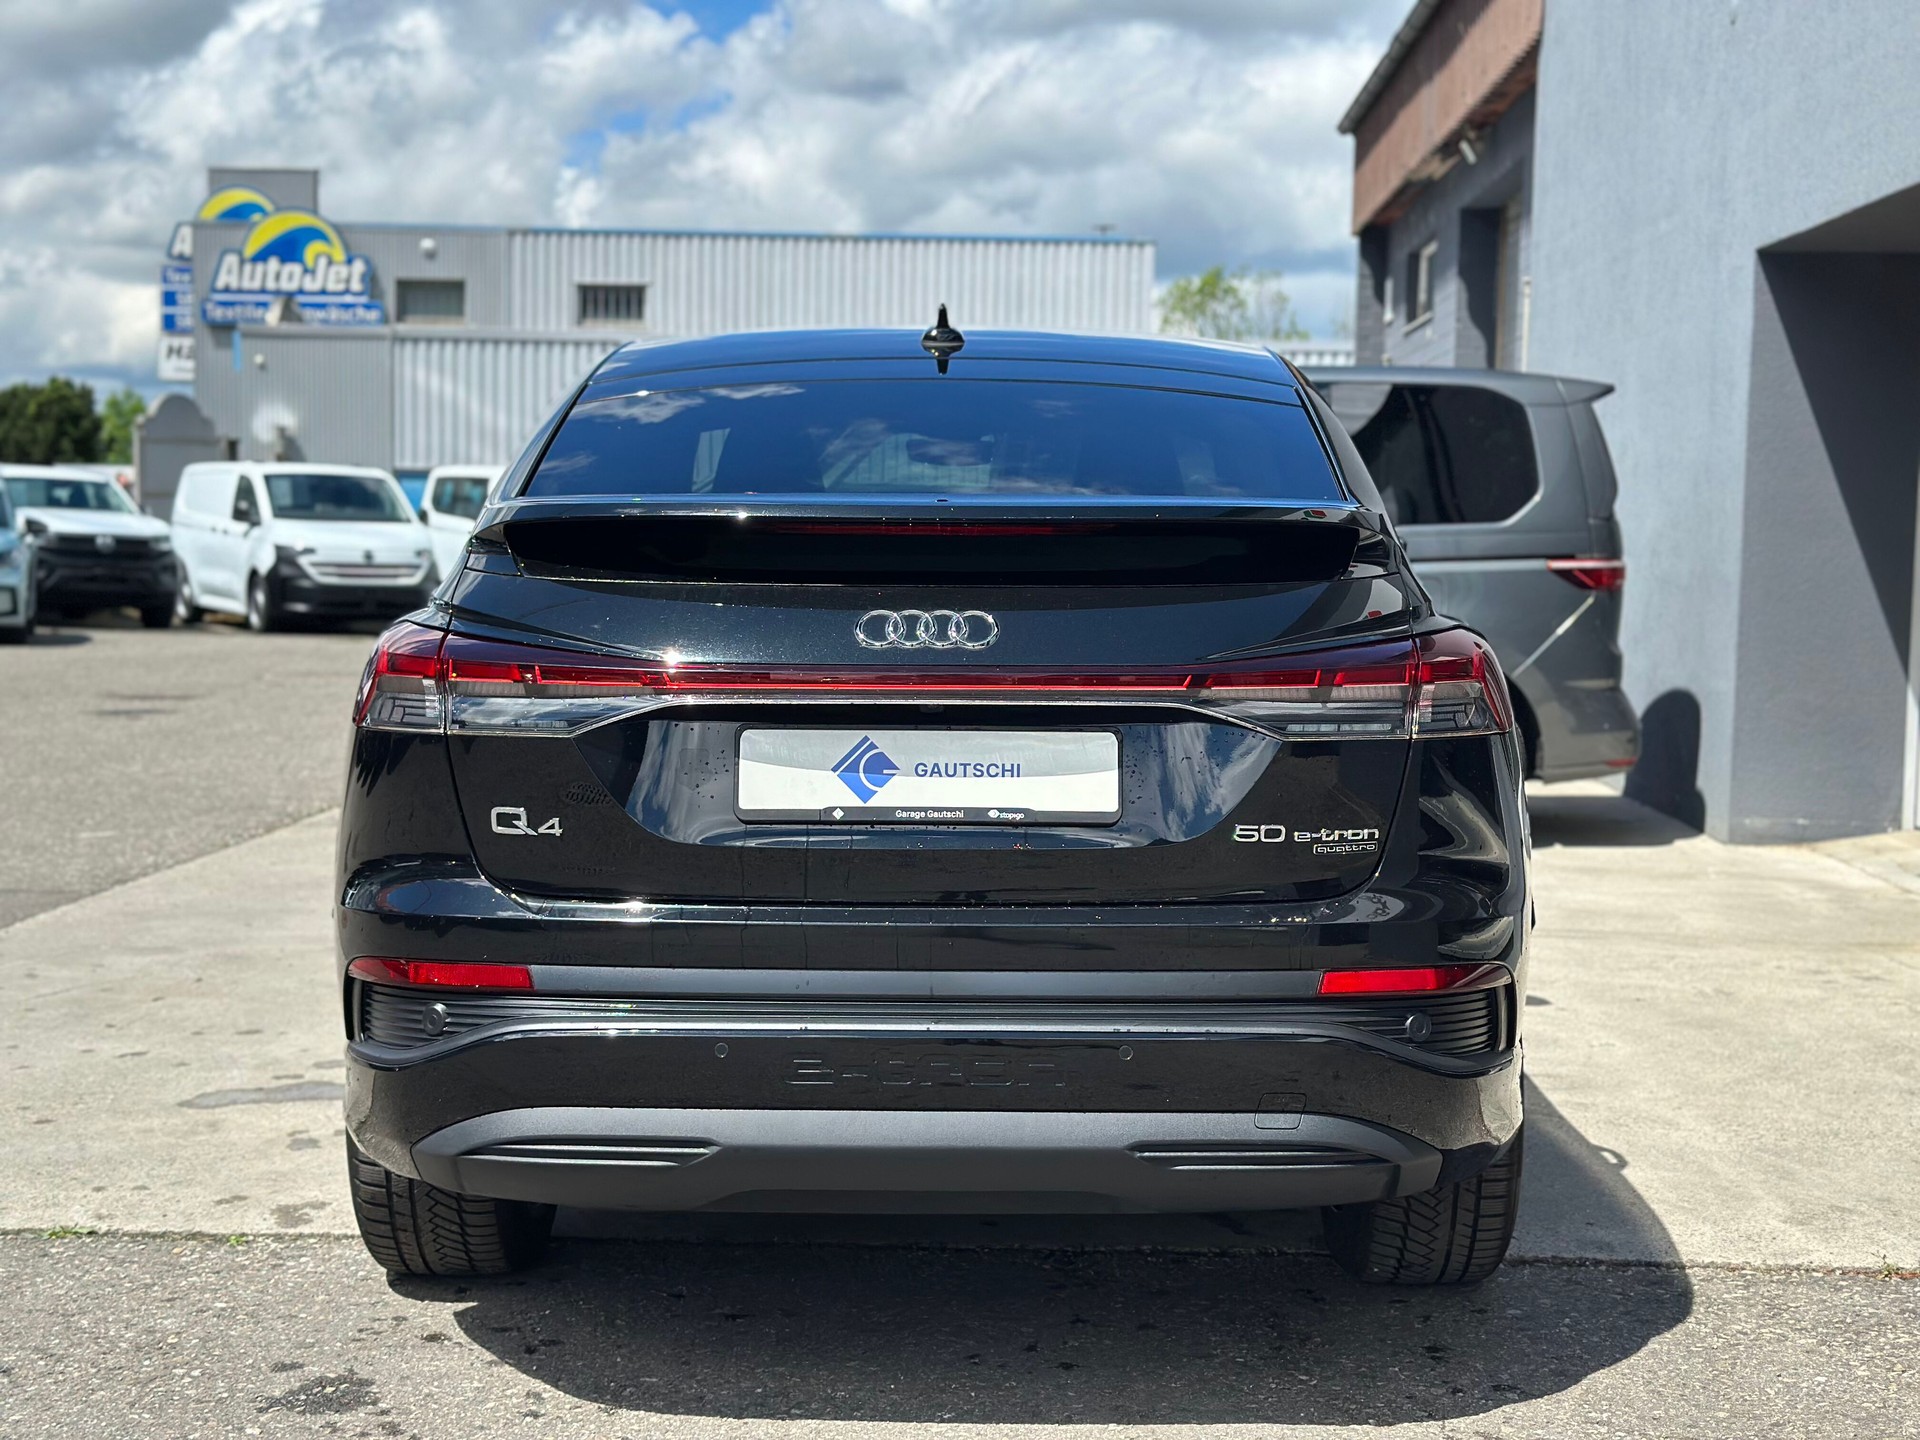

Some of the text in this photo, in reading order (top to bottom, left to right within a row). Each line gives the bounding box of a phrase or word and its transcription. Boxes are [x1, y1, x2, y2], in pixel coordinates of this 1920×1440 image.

[213, 252, 369, 294] AutoJet
[914, 762, 1021, 778] GAUTSCHI
[490, 806, 564, 837] Q4
[895, 809, 965, 820] Garage Gautschi
[1233, 824, 1380, 843] 50 e-tron
[1315, 843, 1376, 854] quattro
